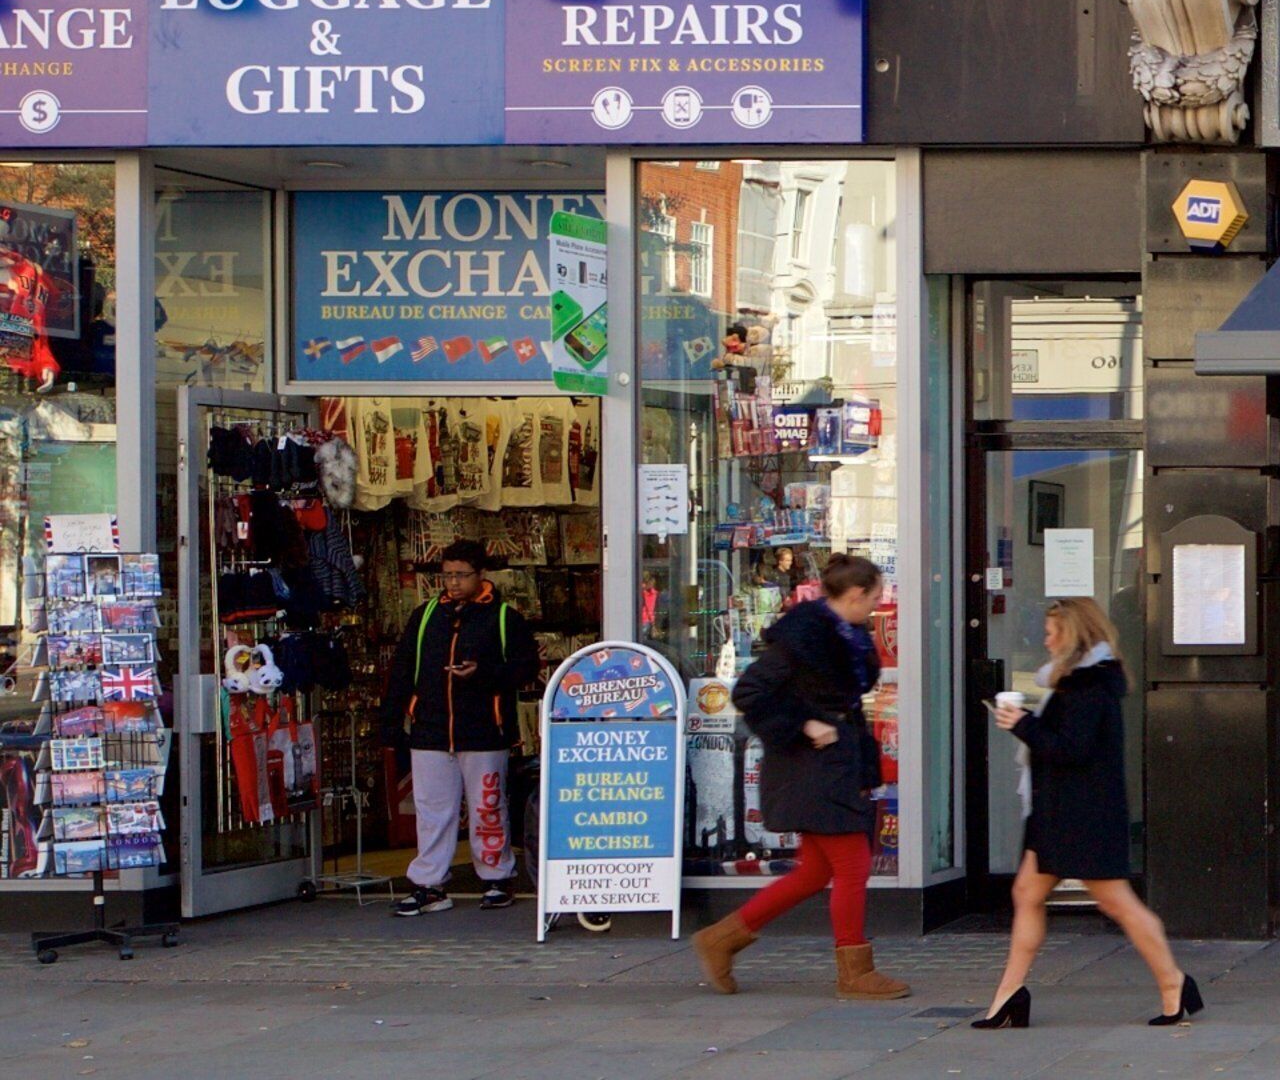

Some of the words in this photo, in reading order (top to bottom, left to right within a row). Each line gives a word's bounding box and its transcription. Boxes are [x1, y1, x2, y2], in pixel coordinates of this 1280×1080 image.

[561, 3, 803, 46] REPAIRS
[309, 18, 342, 56] &
[542, 58, 622, 72] SCREEN
[630, 58, 661, 72] FIX
[668, 58, 680, 71] &
[688, 57, 825, 72] ACCESSORIES
[225, 64, 426, 115] GIFTS
[383, 193, 607, 241] MON
[1187, 202, 1221, 219] ADT
[321, 305, 394, 320] BUREAU
[400, 305, 424, 320] DE
[428, 305, 507, 320] CHANGE
[567, 674, 657, 698] CURRENCIES
[582, 687, 643, 707] BUREAU
[576, 730, 650, 746] MONEY
[557, 746, 668, 763] EXCHANGE
[575, 772, 648, 786] BUREAU
[559, 789, 584, 802] DE
[587, 787, 665, 802] CHANGE
[476, 771, 505, 868] adidas
[574, 811, 648, 826] CAMBIO
[568, 835, 655, 850] WECHSEL
[566, 862, 654, 875] PHOTOCOPY
[559, 894, 569, 905] &
[572, 893, 597, 905] FAX
[601, 891, 660, 905] SERVICE
